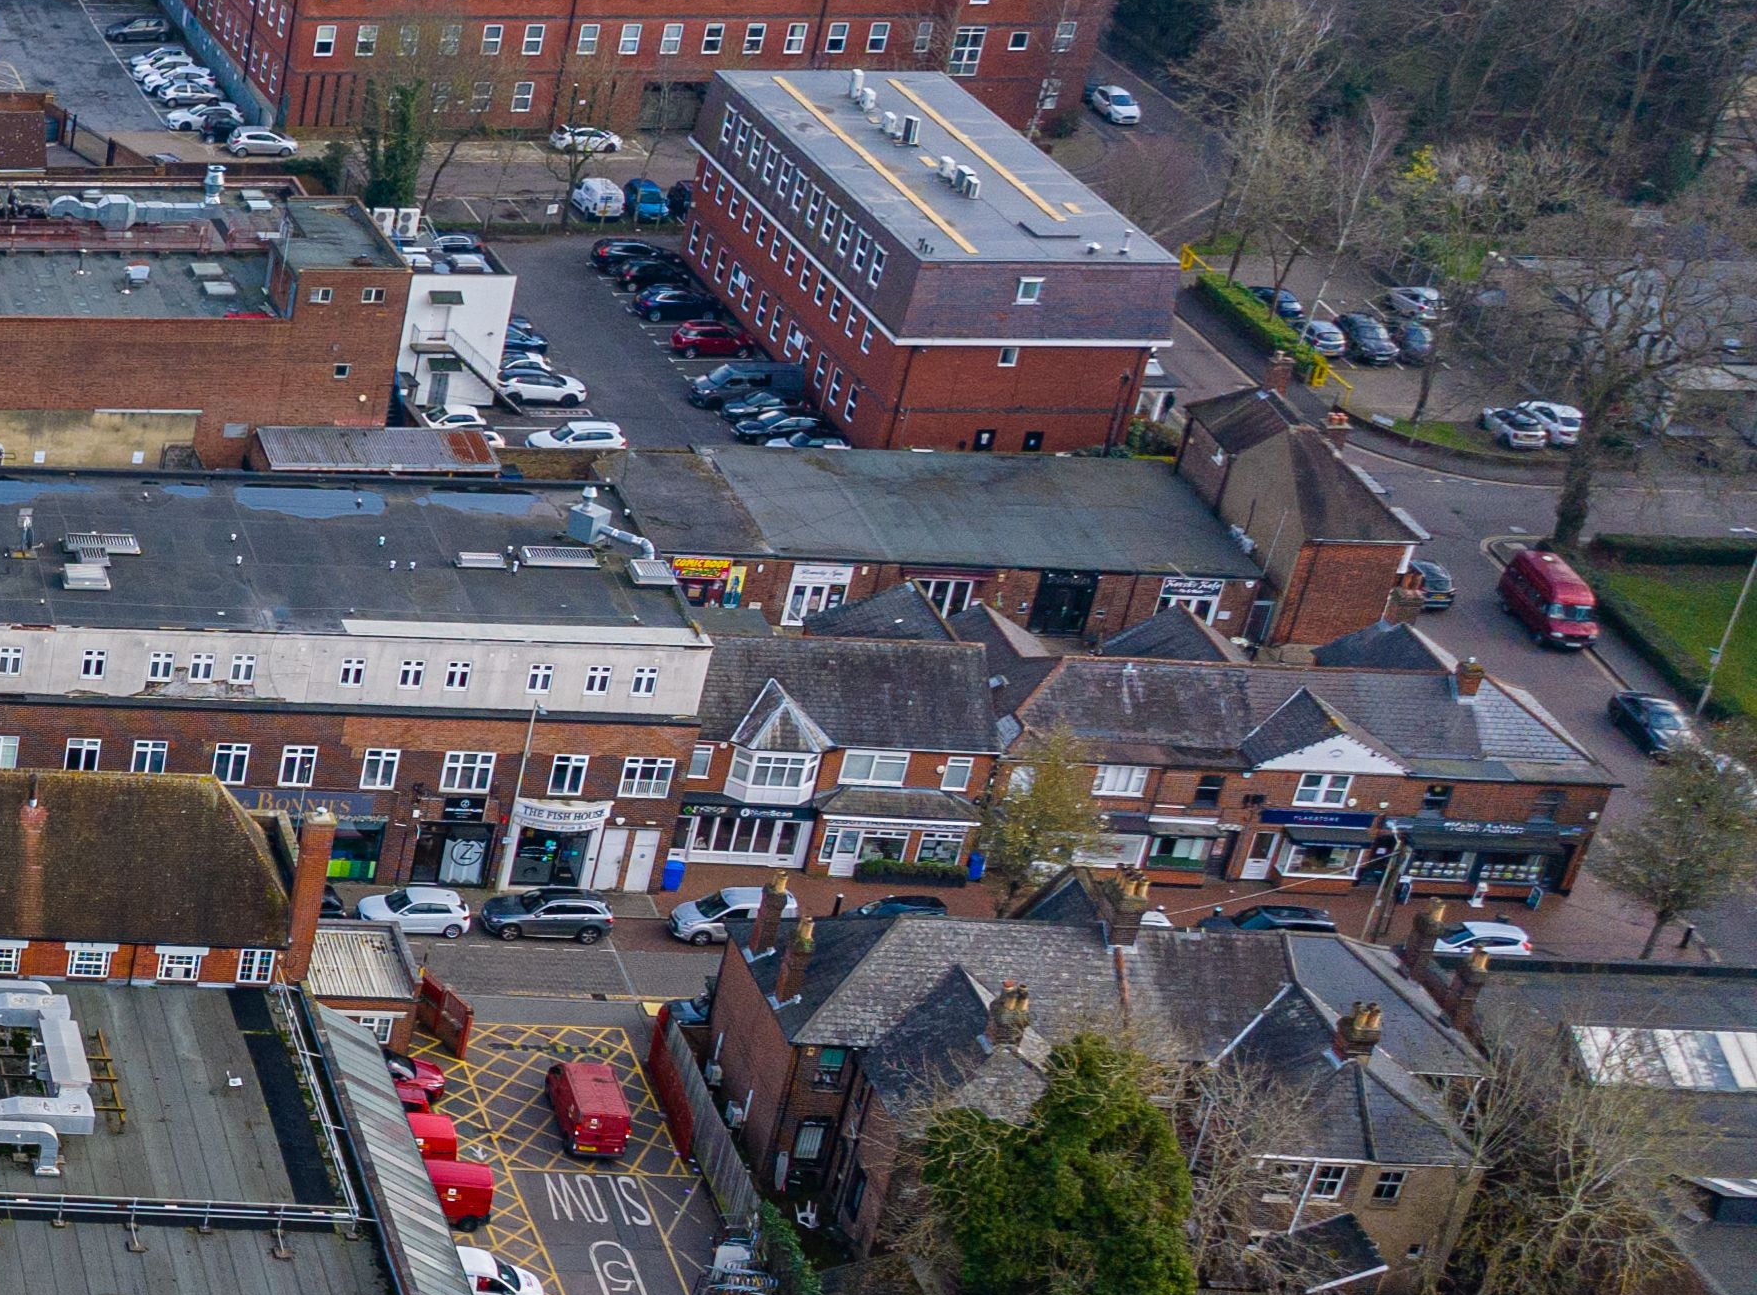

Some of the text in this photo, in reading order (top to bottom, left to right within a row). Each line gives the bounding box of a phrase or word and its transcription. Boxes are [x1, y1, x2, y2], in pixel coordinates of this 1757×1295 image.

[674, 558, 731, 569] COMIC BOOK
[523, 806, 605, 821] THE FISH HOUSE
[543, 1173, 652, 1226] SLOW
[602, 1260, 636, 1292] 5
